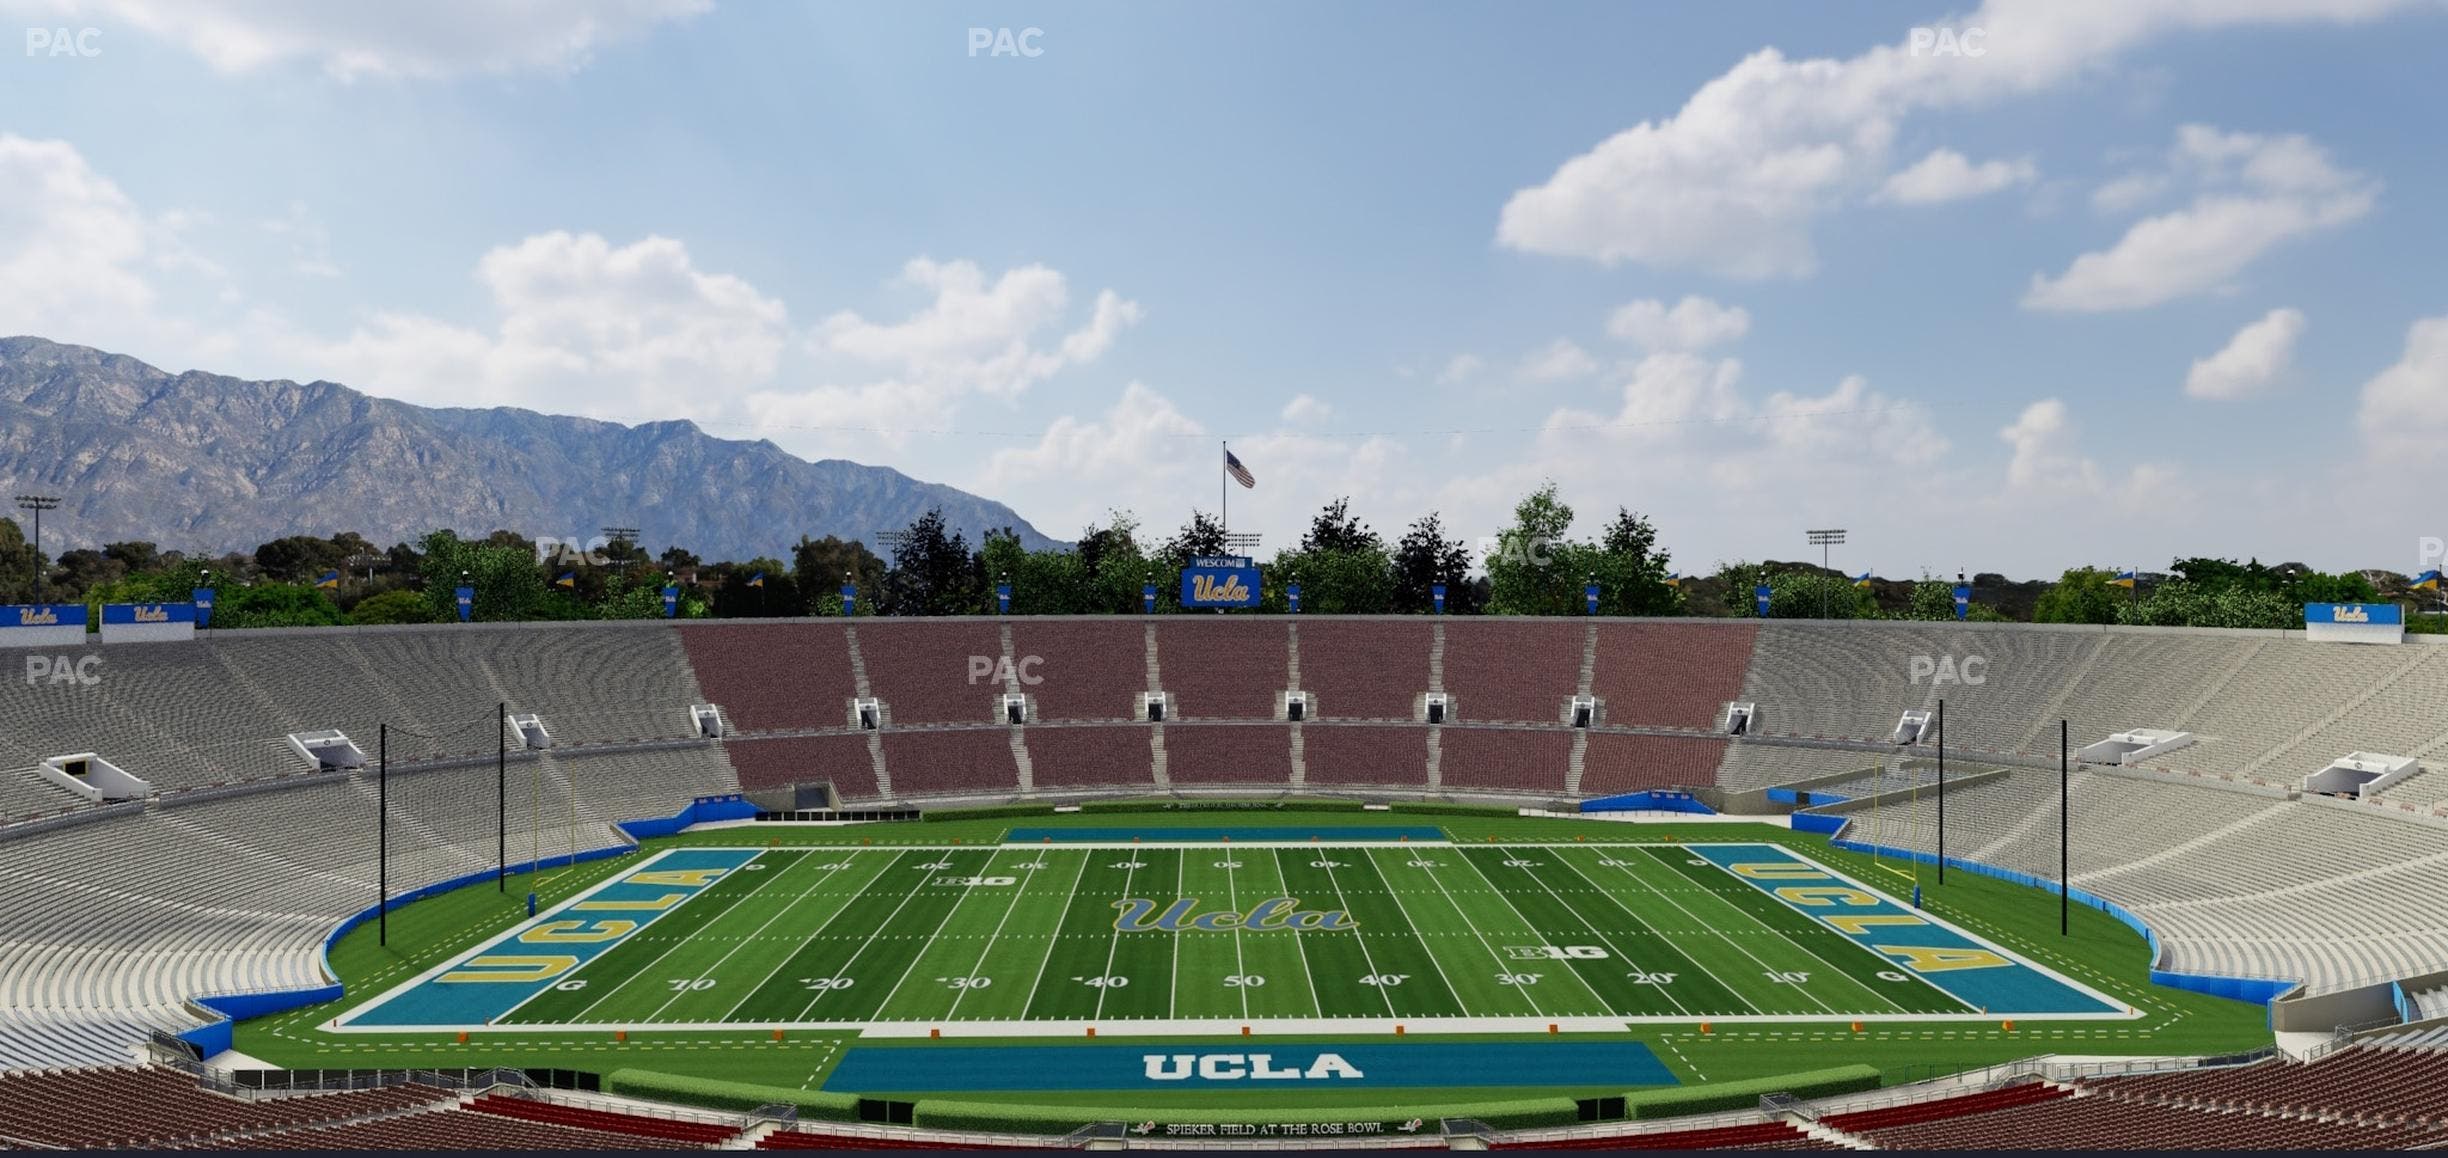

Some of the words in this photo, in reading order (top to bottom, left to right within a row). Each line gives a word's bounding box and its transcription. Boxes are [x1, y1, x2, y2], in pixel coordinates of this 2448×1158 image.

[1196, 558, 1235, 568] WESCOM
[1192, 574, 1250, 602] Ucla
[20, 608, 58, 625] Ucla
[133, 606, 168, 622] Ucla
[2331, 606, 2369, 622] Ucla
[1110, 897, 1361, 932] Ucla
[1728, 862, 2017, 973] UCLA
[432, 868, 731, 983] UCLA
[1083, 976, 1130, 988] 40
[1223, 975, 1266, 987] 50
[1358, 974, 1402, 986] 40
[1494, 973, 1538, 985] 30
[1626, 972, 1675, 984] 20
[1763, 971, 1809, 983] 10
[1875, 970, 1909, 982] G
[556, 980, 588, 991] G
[670, 979, 717, 991] 10
[804, 978, 855, 990] 20
[947, 977, 992, 989] 30
[1143, 1053, 1364, 1080] UCLA
[1166, 1123, 1216, 1136] SPIEKER
[1219, 1123, 1256, 1136] FIELD
[1260, 1123, 1277, 1136] AT
[1281, 1123, 1307, 1136] THE
[1311, 1122, 1343, 1135] ROSE
[1347, 1121, 1384, 1134] BOWL
